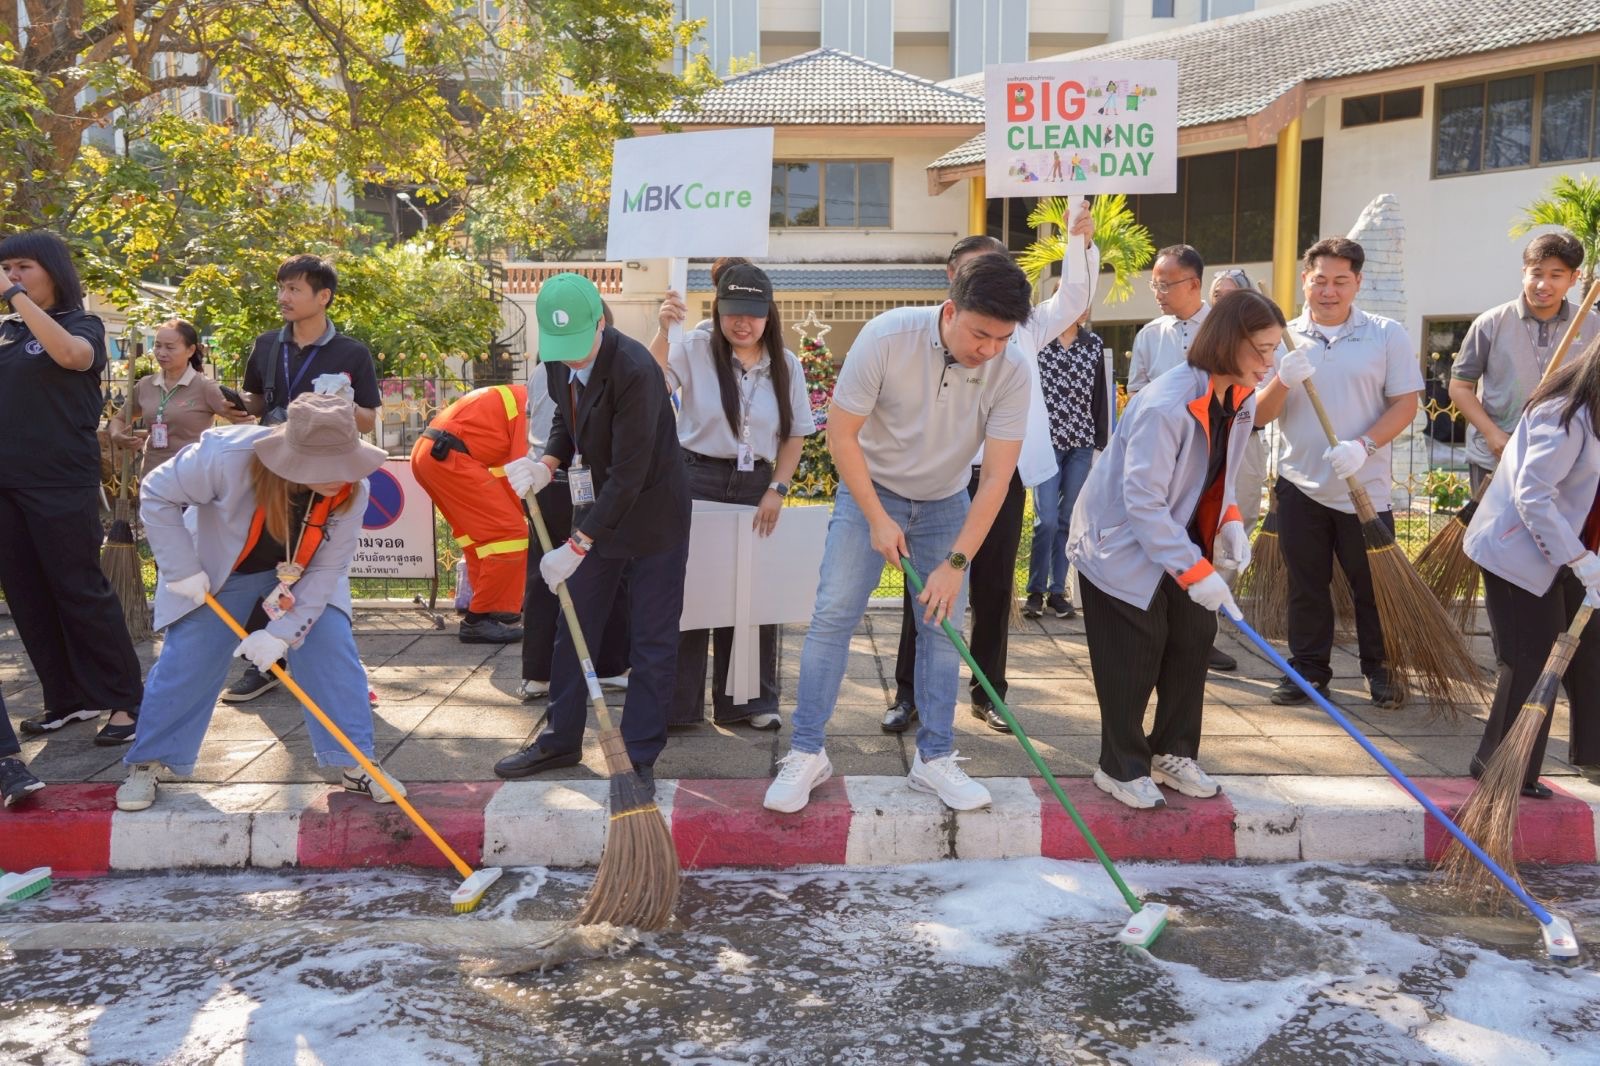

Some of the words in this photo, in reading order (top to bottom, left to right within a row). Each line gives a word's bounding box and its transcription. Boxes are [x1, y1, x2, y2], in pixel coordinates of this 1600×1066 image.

[1007, 80, 1086, 122] BIG
[1100, 152, 1154, 177] DAY
[358, 537, 404, 548] ามจอด
